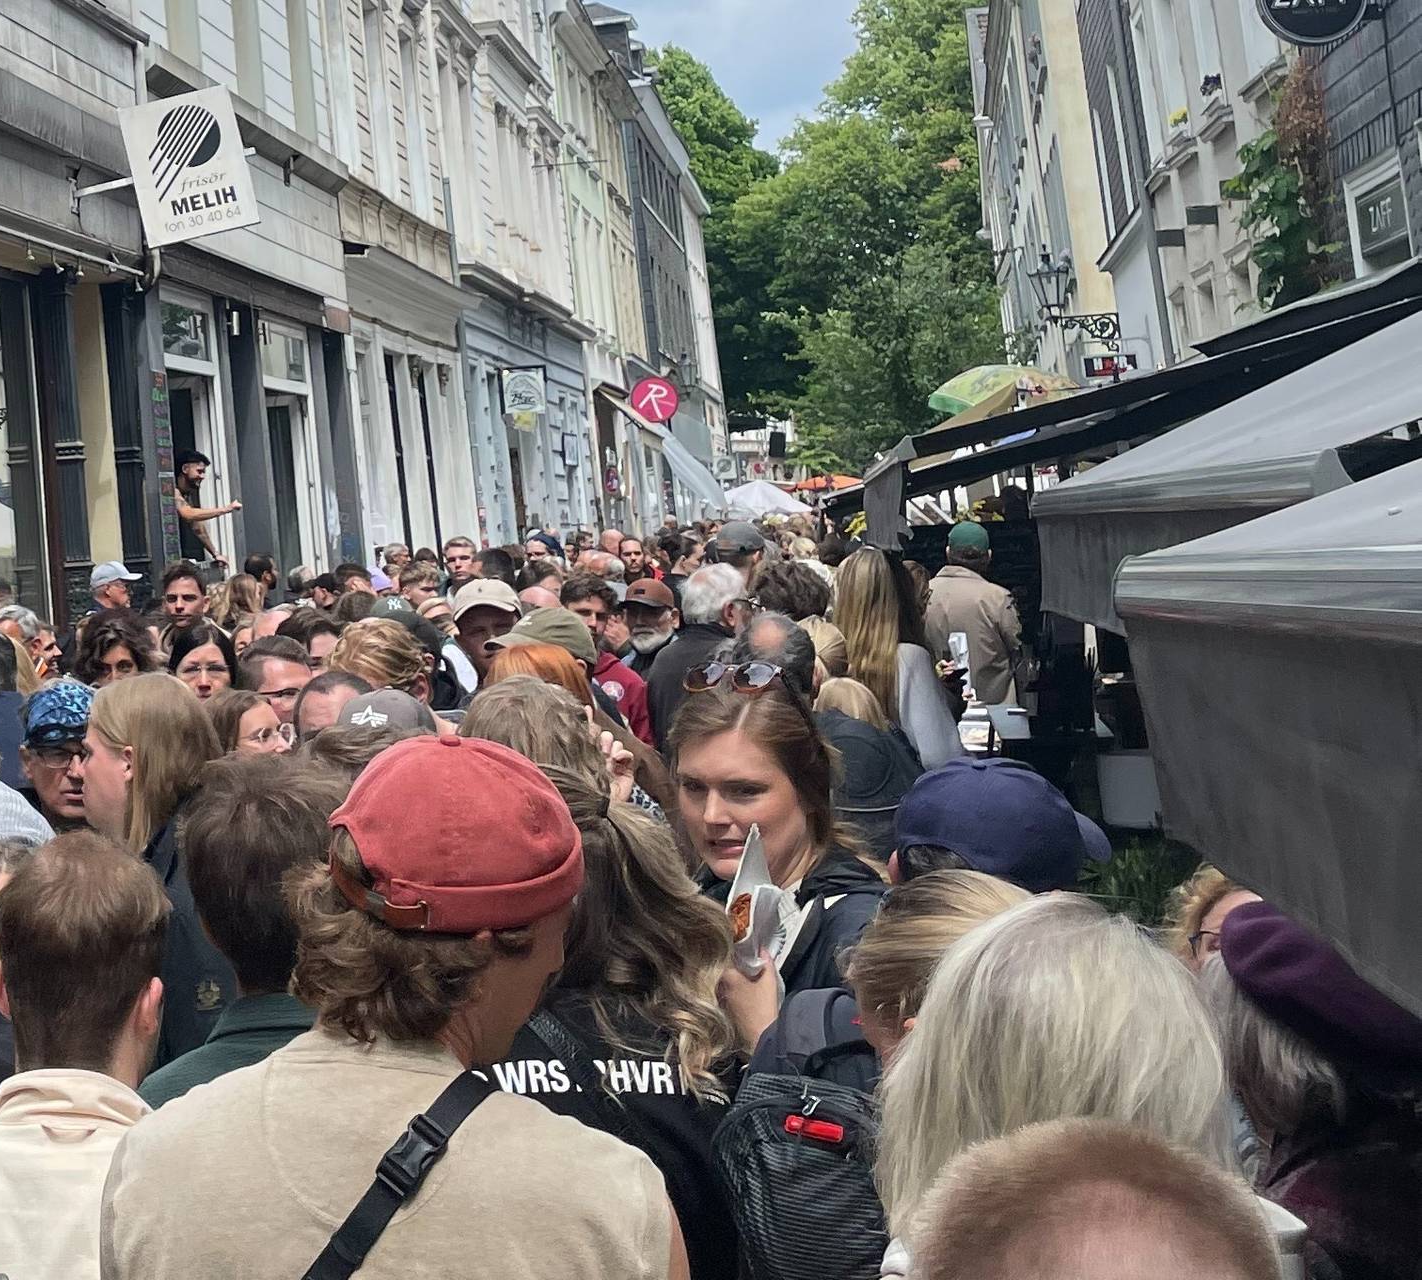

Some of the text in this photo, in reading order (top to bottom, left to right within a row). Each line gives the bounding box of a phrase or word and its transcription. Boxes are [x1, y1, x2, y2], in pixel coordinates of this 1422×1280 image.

[179, 172, 227, 194] frisör
[171, 186, 237, 216] MELIH
[188, 214, 203, 227] 30
[208, 209, 223, 222] 40
[226, 205, 241, 217] 64
[638, 383, 668, 419] R
